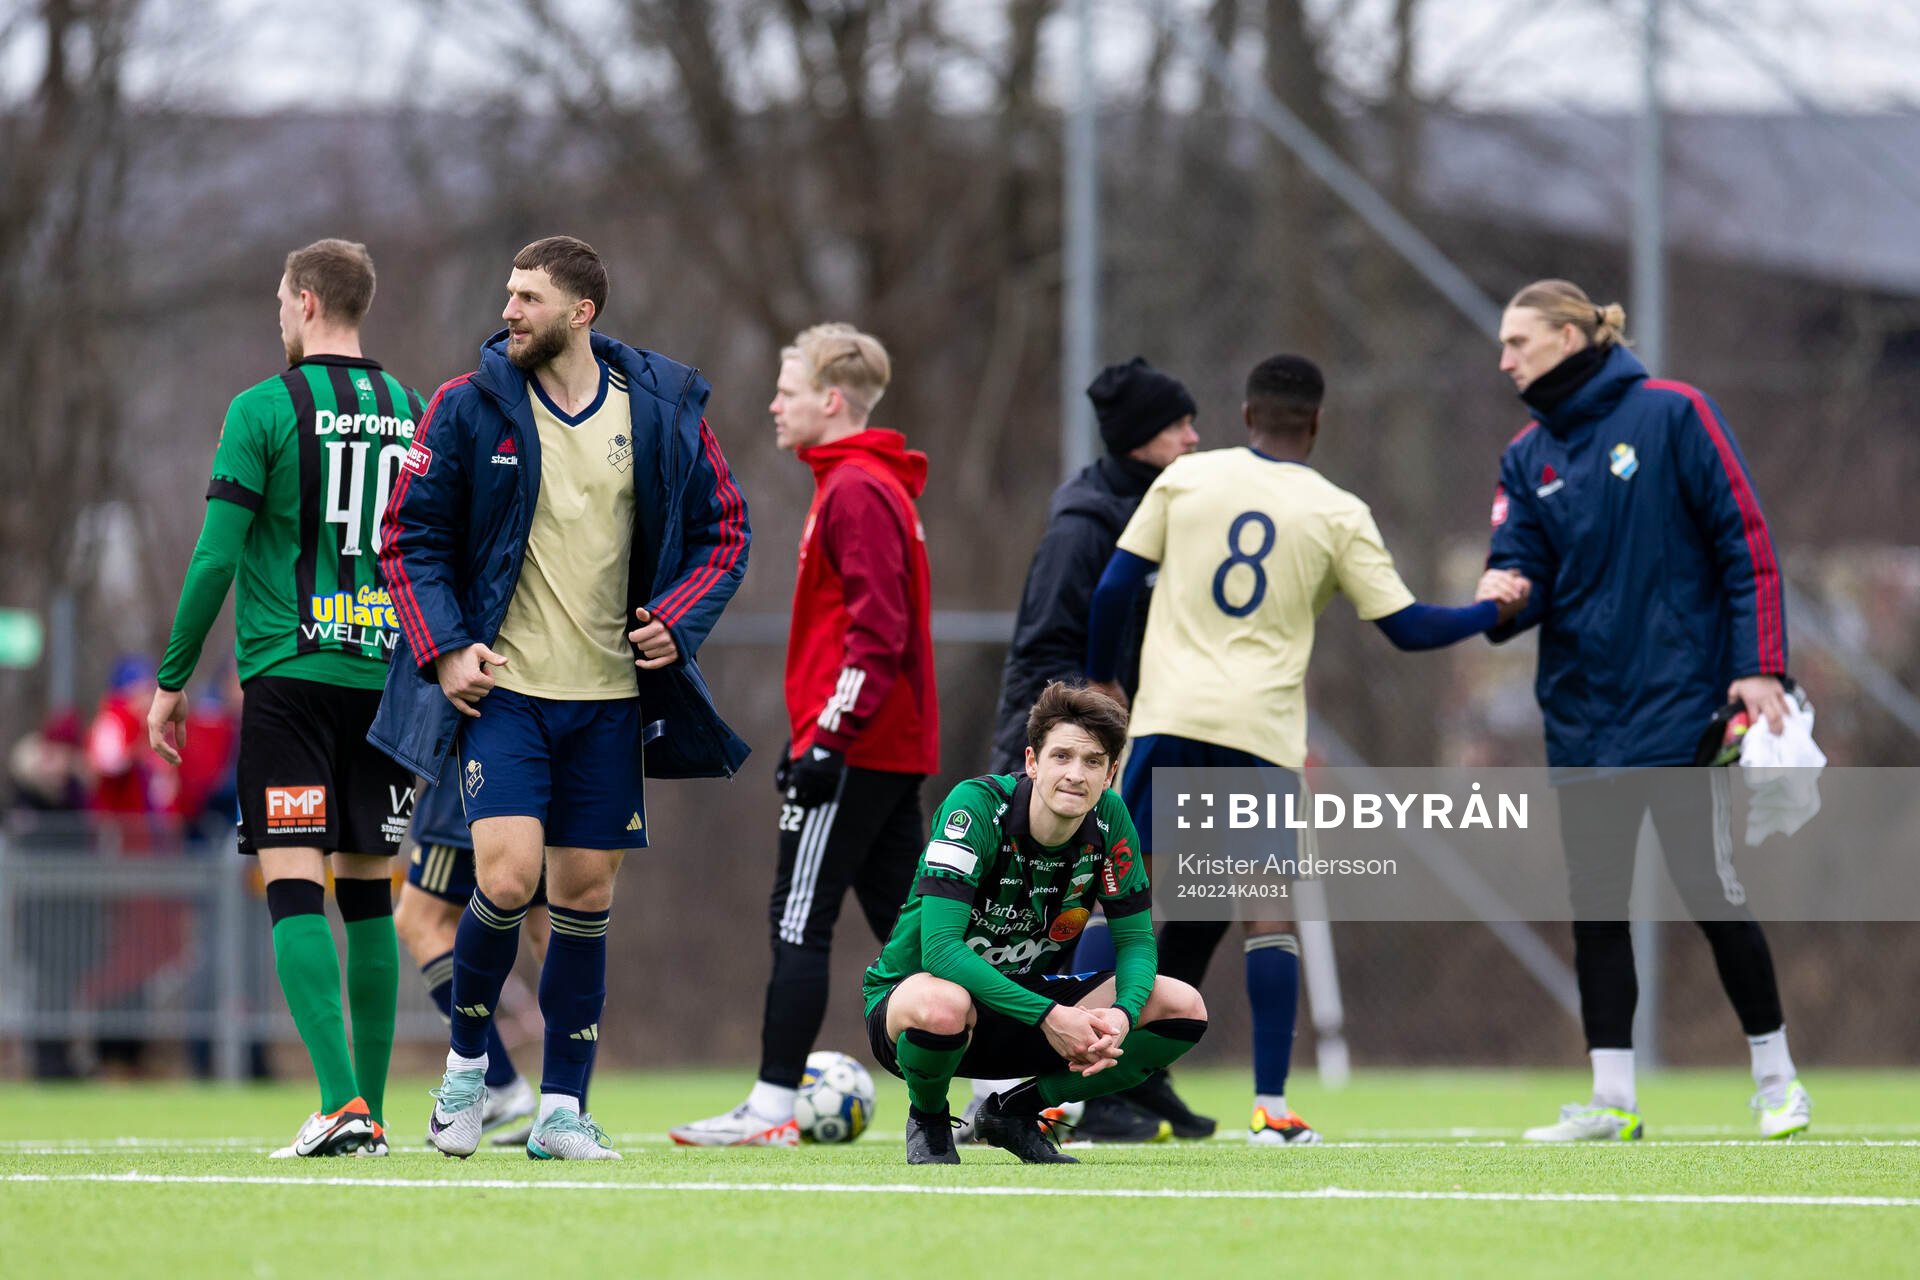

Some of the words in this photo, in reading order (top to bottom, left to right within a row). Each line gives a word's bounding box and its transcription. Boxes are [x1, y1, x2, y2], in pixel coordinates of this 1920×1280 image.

[315, 409, 416, 439] Derome
[1212, 510, 1277, 619] 8
[267, 789, 323, 816] FMP
[779, 803, 804, 831] 22
